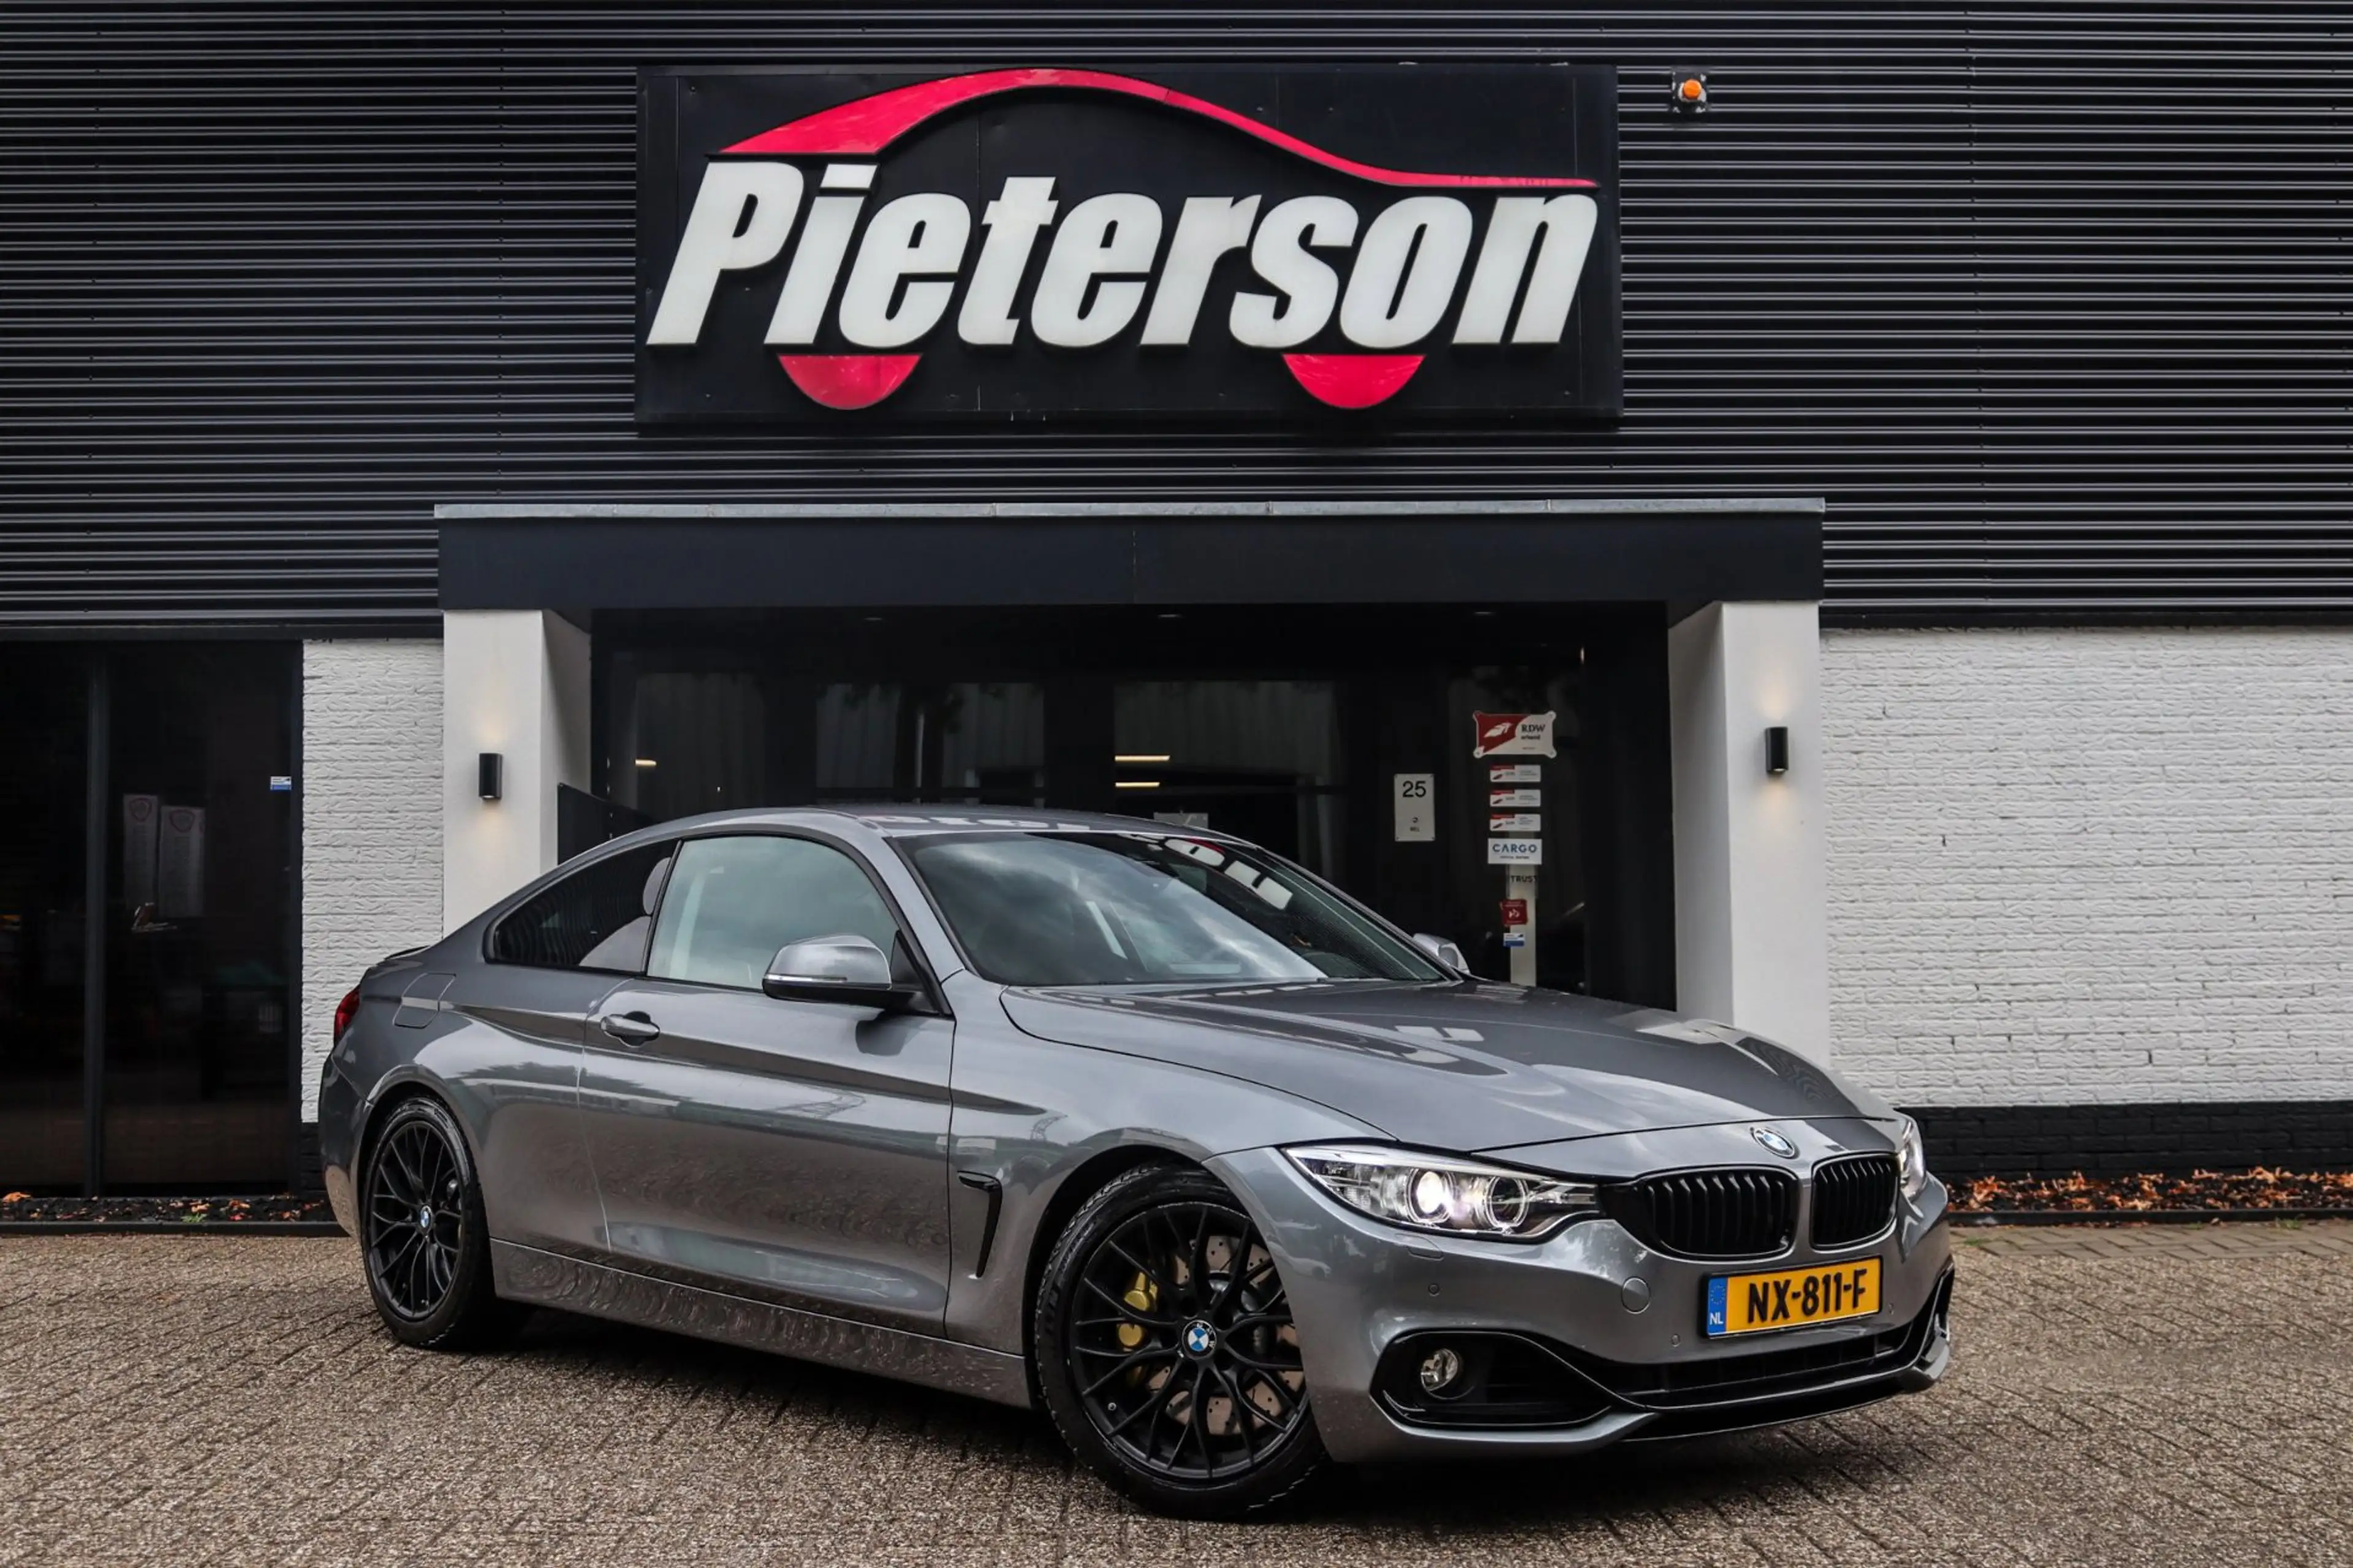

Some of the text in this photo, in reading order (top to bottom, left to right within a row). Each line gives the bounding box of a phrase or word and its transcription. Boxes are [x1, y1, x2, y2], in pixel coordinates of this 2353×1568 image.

[645, 161, 1598, 348] Pieterson
[1403, 781, 1427, 798] 25
[1492, 844, 1537, 853] CARGO
[1748, 1268, 1867, 1324] NX-811-F
[1710, 1312, 1723, 1325] NL
